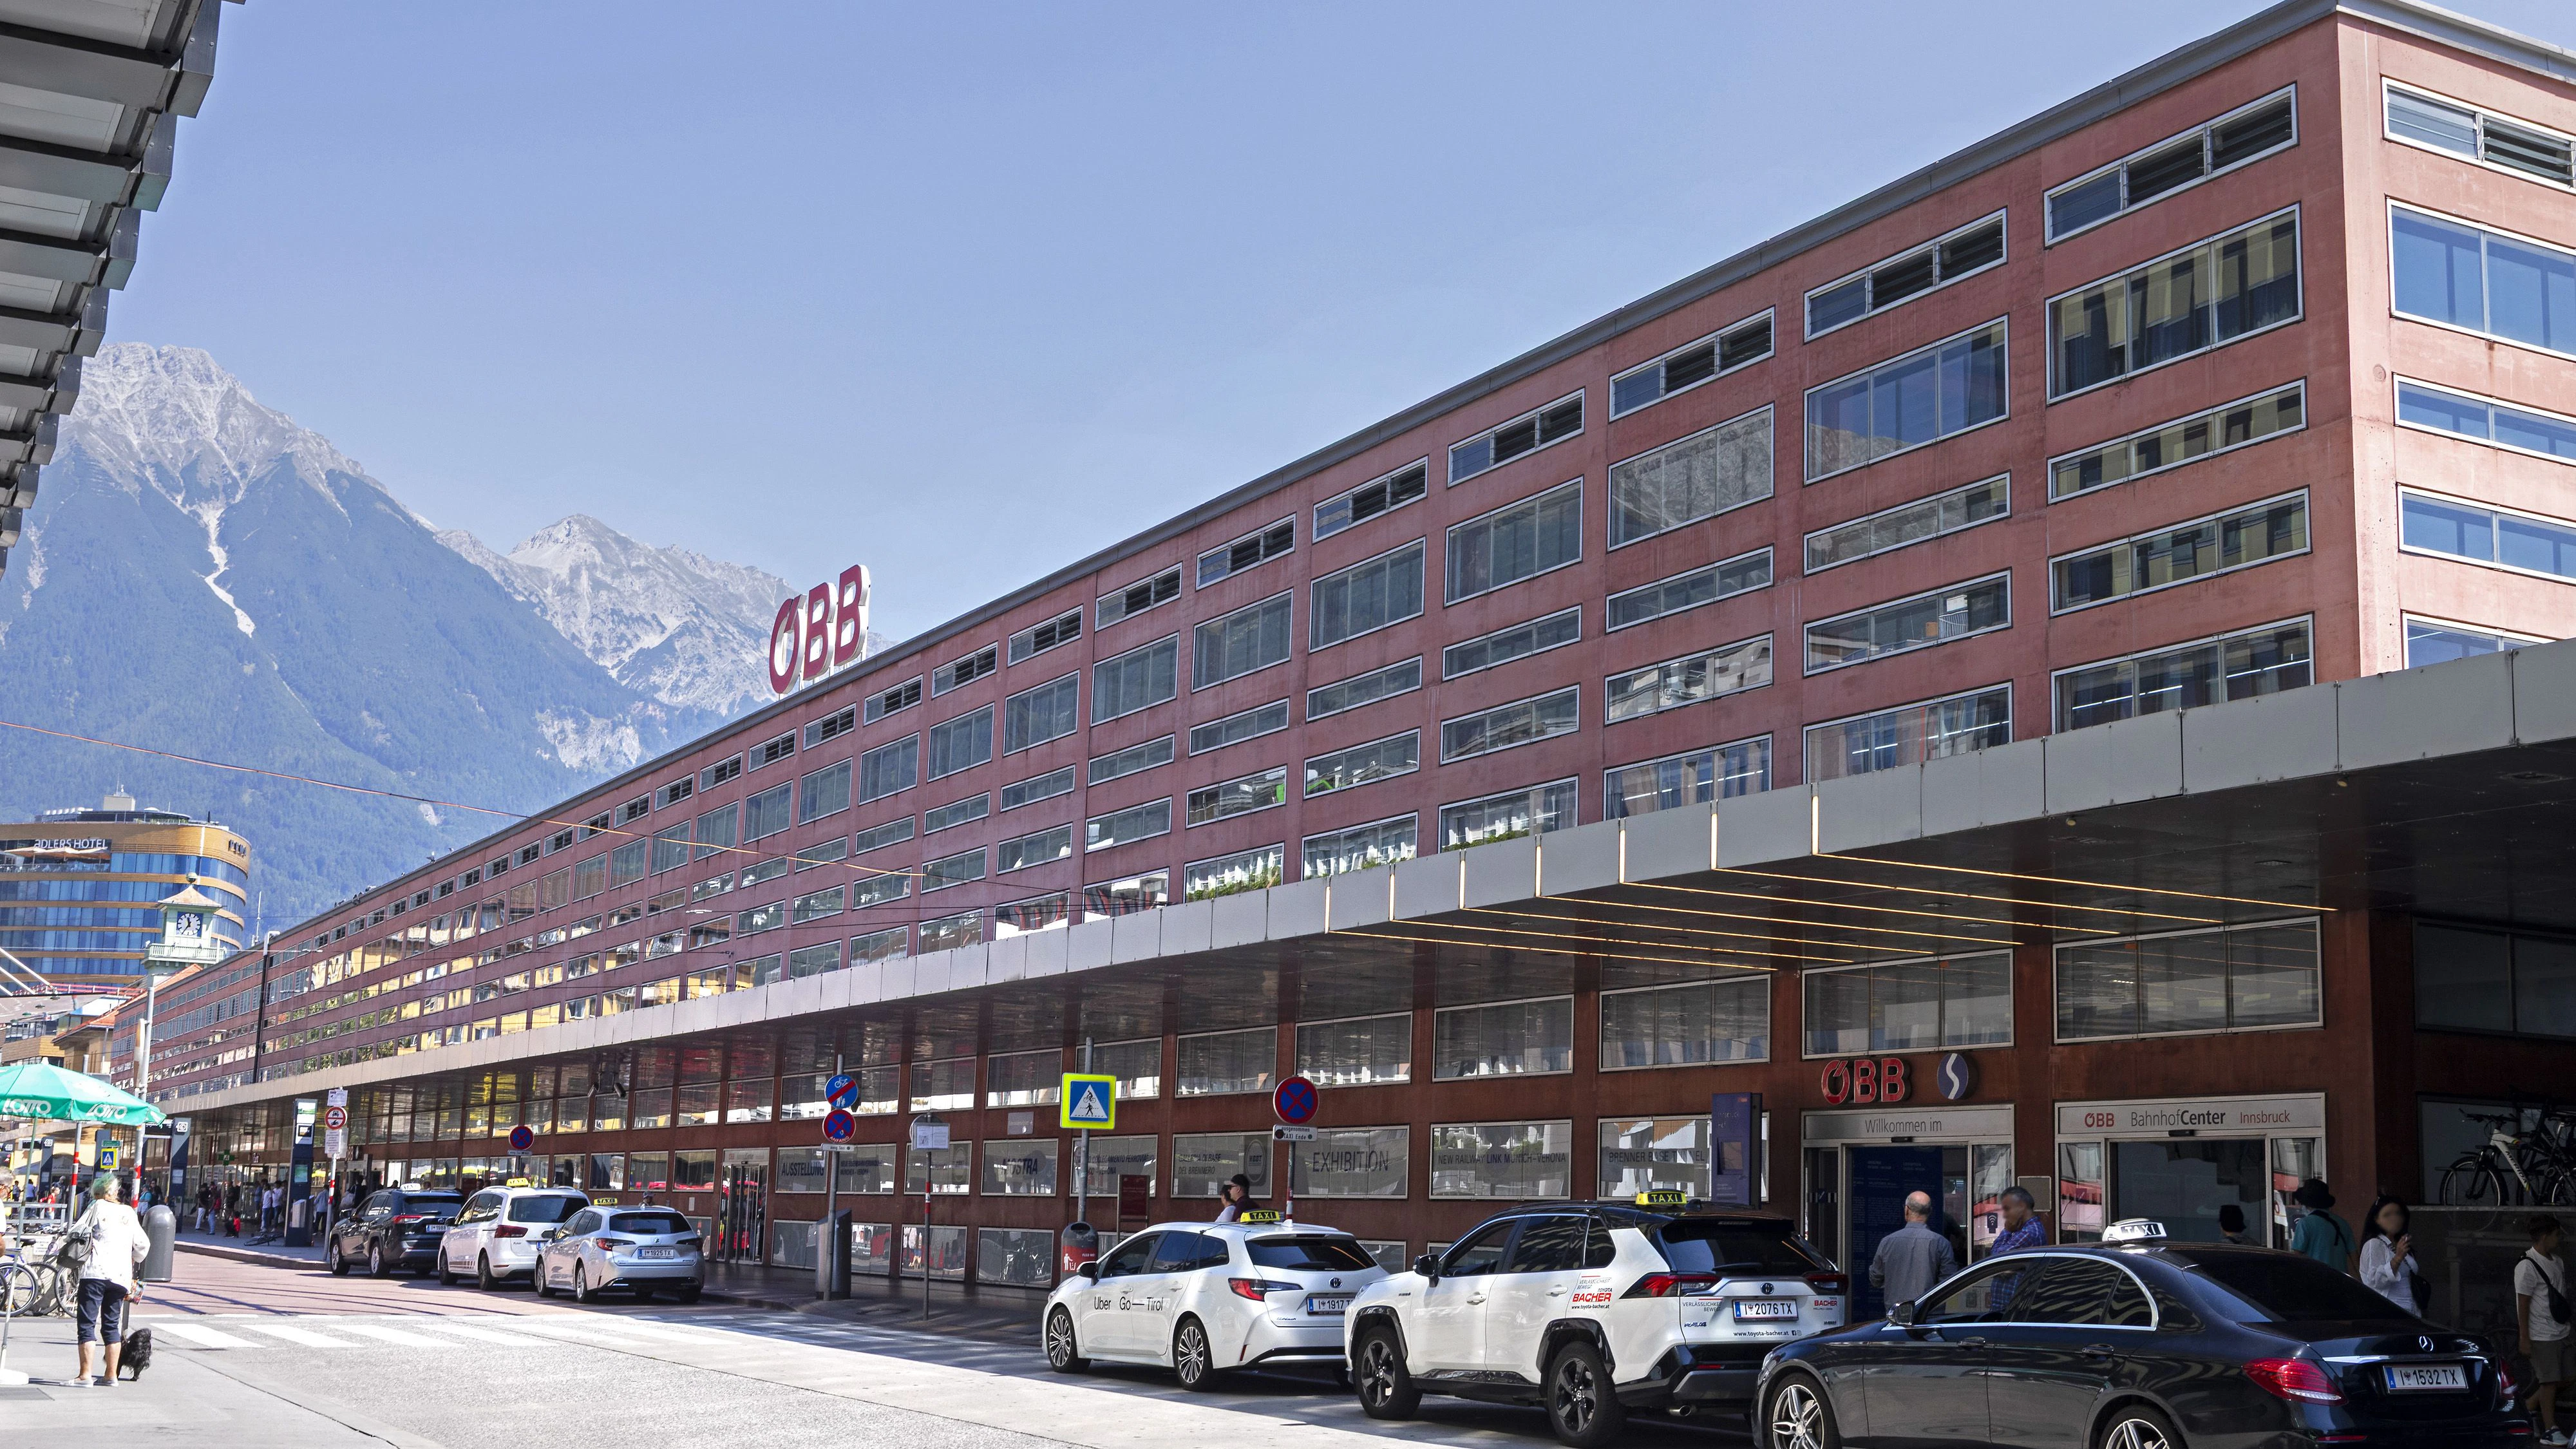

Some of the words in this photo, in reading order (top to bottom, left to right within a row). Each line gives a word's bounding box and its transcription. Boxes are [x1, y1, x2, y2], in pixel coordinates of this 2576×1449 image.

[770, 564, 867, 694] ÖBB
[73, 838, 108, 849] HOTEL
[1821, 1057, 1905, 1105] ÖBB
[86, 1103, 128, 1119] LOTTO
[1865, 1118, 1926, 1134] Willkommen
[1929, 1117, 1942, 1132] im
[2084, 1112, 2115, 1128] ÖBB
[2131, 1110, 2226, 1127] BahnhofCenter
[2240, 1110, 2290, 1124] Innsbruck
[1312, 1150, 1389, 1173] EXHIBITION
[1438, 1155, 1453, 1164] NEW
[1455, 1154, 1485, 1164] RAILWAY
[1486, 1154, 1501, 1163] LINK
[1609, 1151, 1645, 1162] BRENNER
[1648, 1151, 1669, 1162] BASE
[781, 1161, 824, 1177] AUSSTELLUNG
[1178, 1166, 1187, 1175] DEL
[1188, 1166, 1216, 1175] BRENNERO
[1651, 1194, 1678, 1202] TAXI
[2124, 1224, 2156, 1235] TAXI
[1094, 1296, 1112, 1311] Uber
[1572, 1293, 1612, 1302] BACHER
[1318, 1300, 1321, 1310] I
[1327, 1300, 1344, 1310] 1917
[1745, 1303, 1748, 1315] I
[1755, 1303, 1779, 1315] 2076
[1781, 1303, 1792, 1314] TX
[2400, 1370, 2405, 1386] I
[2412, 1369, 2441, 1385] 1532
[2441, 1369, 2458, 1385] TX
